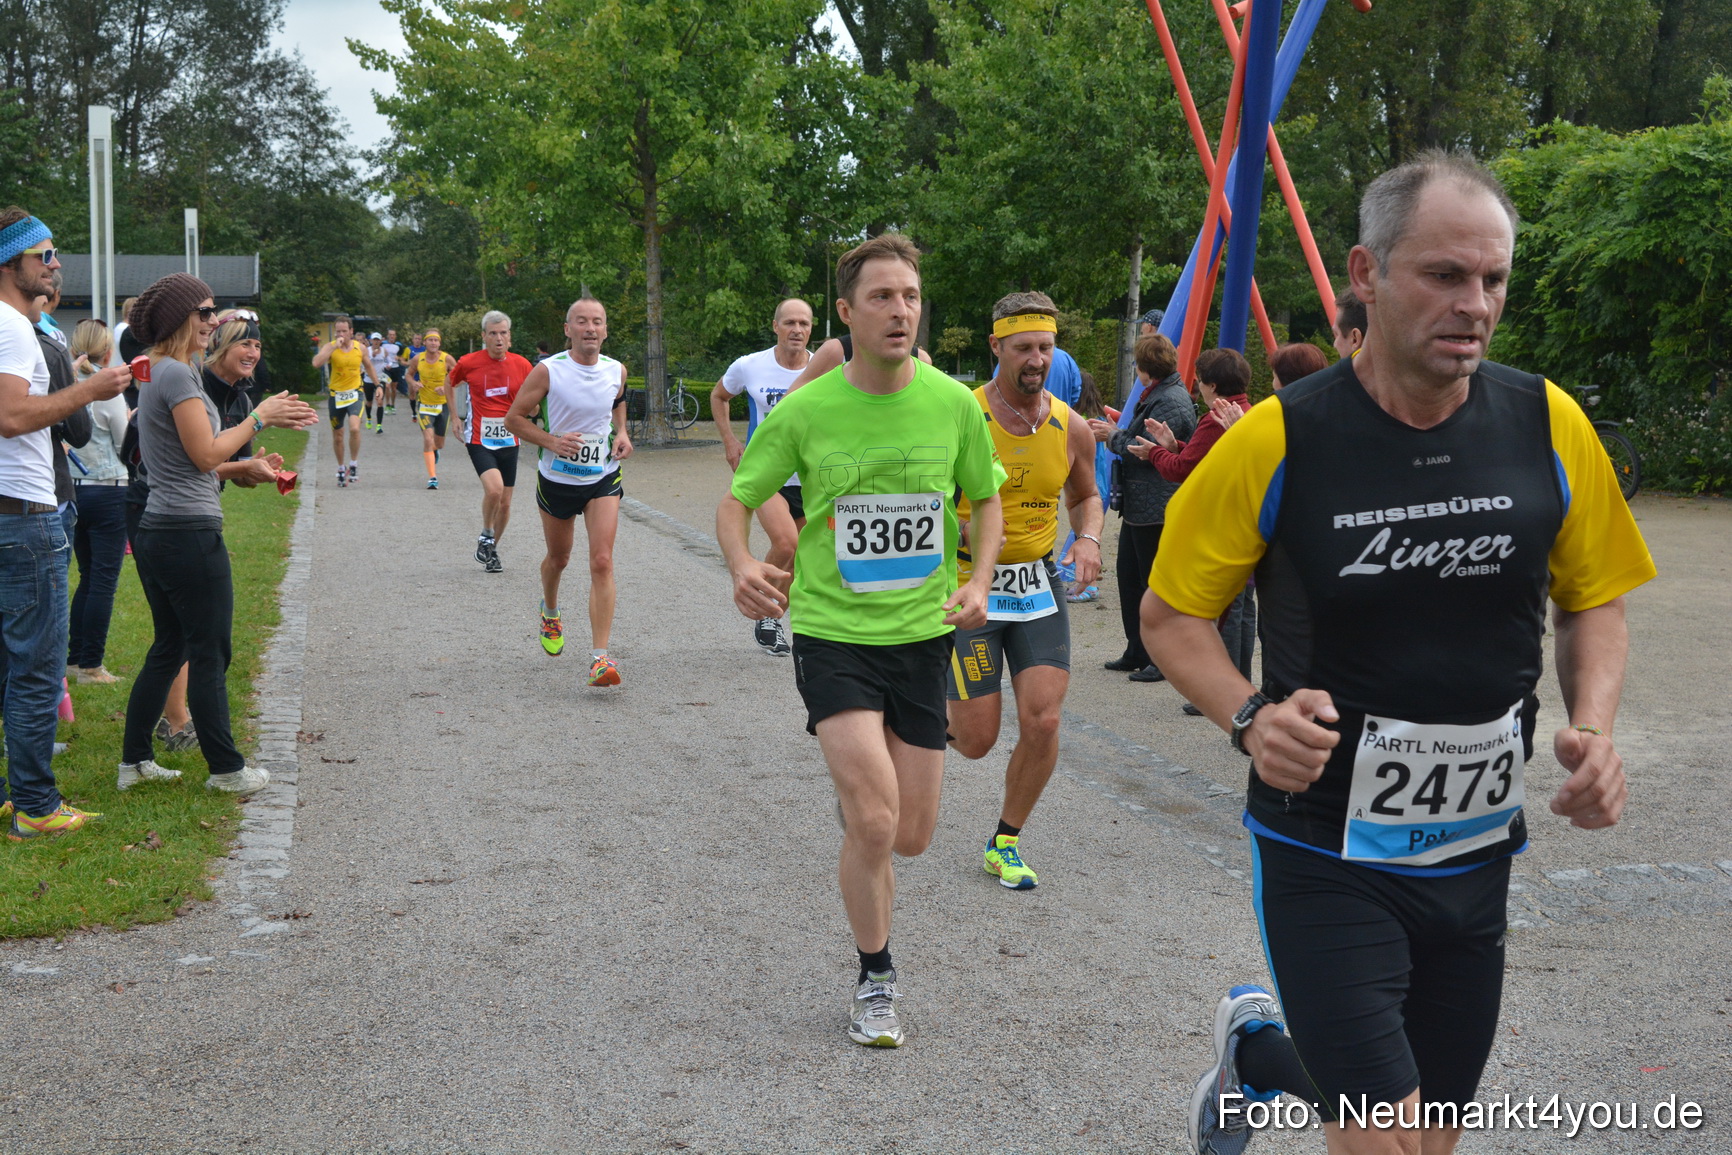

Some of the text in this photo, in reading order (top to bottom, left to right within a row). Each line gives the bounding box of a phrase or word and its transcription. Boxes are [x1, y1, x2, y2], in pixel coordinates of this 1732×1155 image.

[1425, 455, 1451, 465] JAKO
[837, 503, 927, 514] PARTL Neumarkt
[1333, 496, 1513, 529] REISEBÜRO
[846, 516, 935, 555] 3362
[1338, 527, 1516, 578] Linzer
[1456, 564, 1501, 577] GMBH
[974, 643, 993, 671] Run!
[1363, 730, 1510, 756] PARTL Neumarkt
[1370, 750, 1514, 816] 2473
[1355, 808, 1363, 818] A
